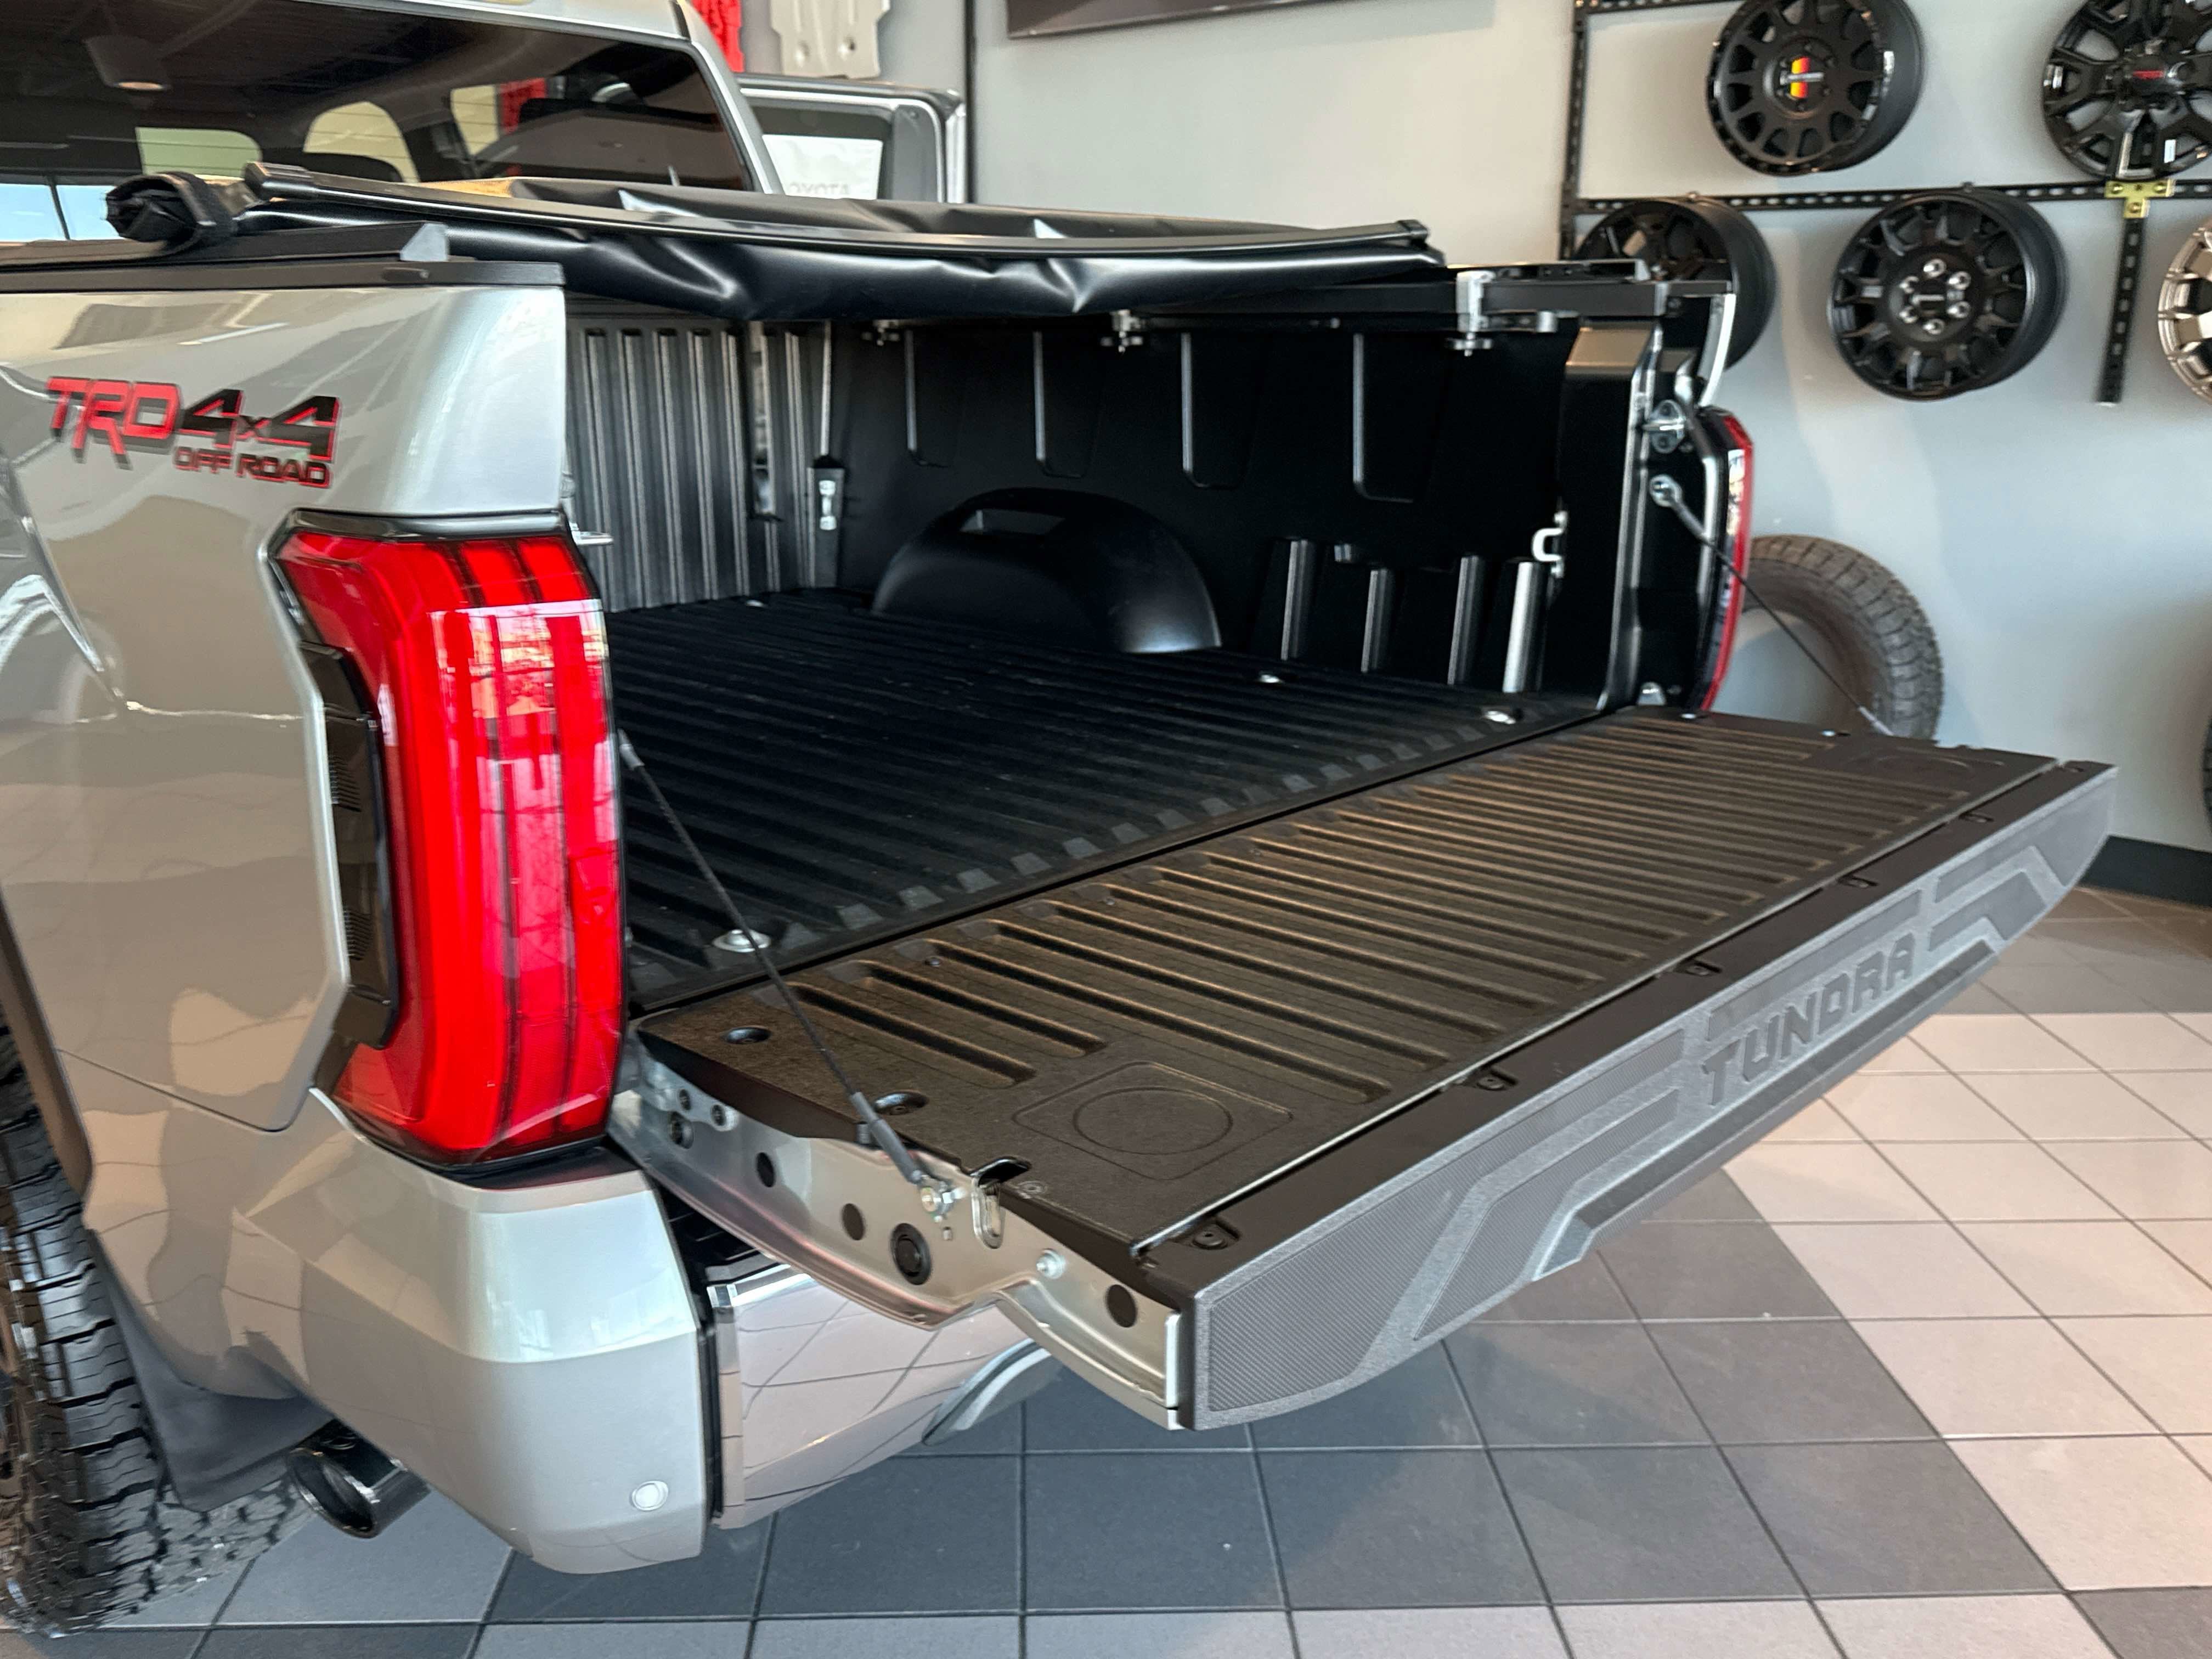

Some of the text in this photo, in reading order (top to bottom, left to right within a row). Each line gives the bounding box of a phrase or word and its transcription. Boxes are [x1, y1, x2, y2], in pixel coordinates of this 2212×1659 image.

[788, 182, 850, 195] OYOTA
[46, 376, 183, 469] TRD
[173, 446, 334, 488] OFF ROAD
[1701, 932, 1916, 1106] TUNDRA
